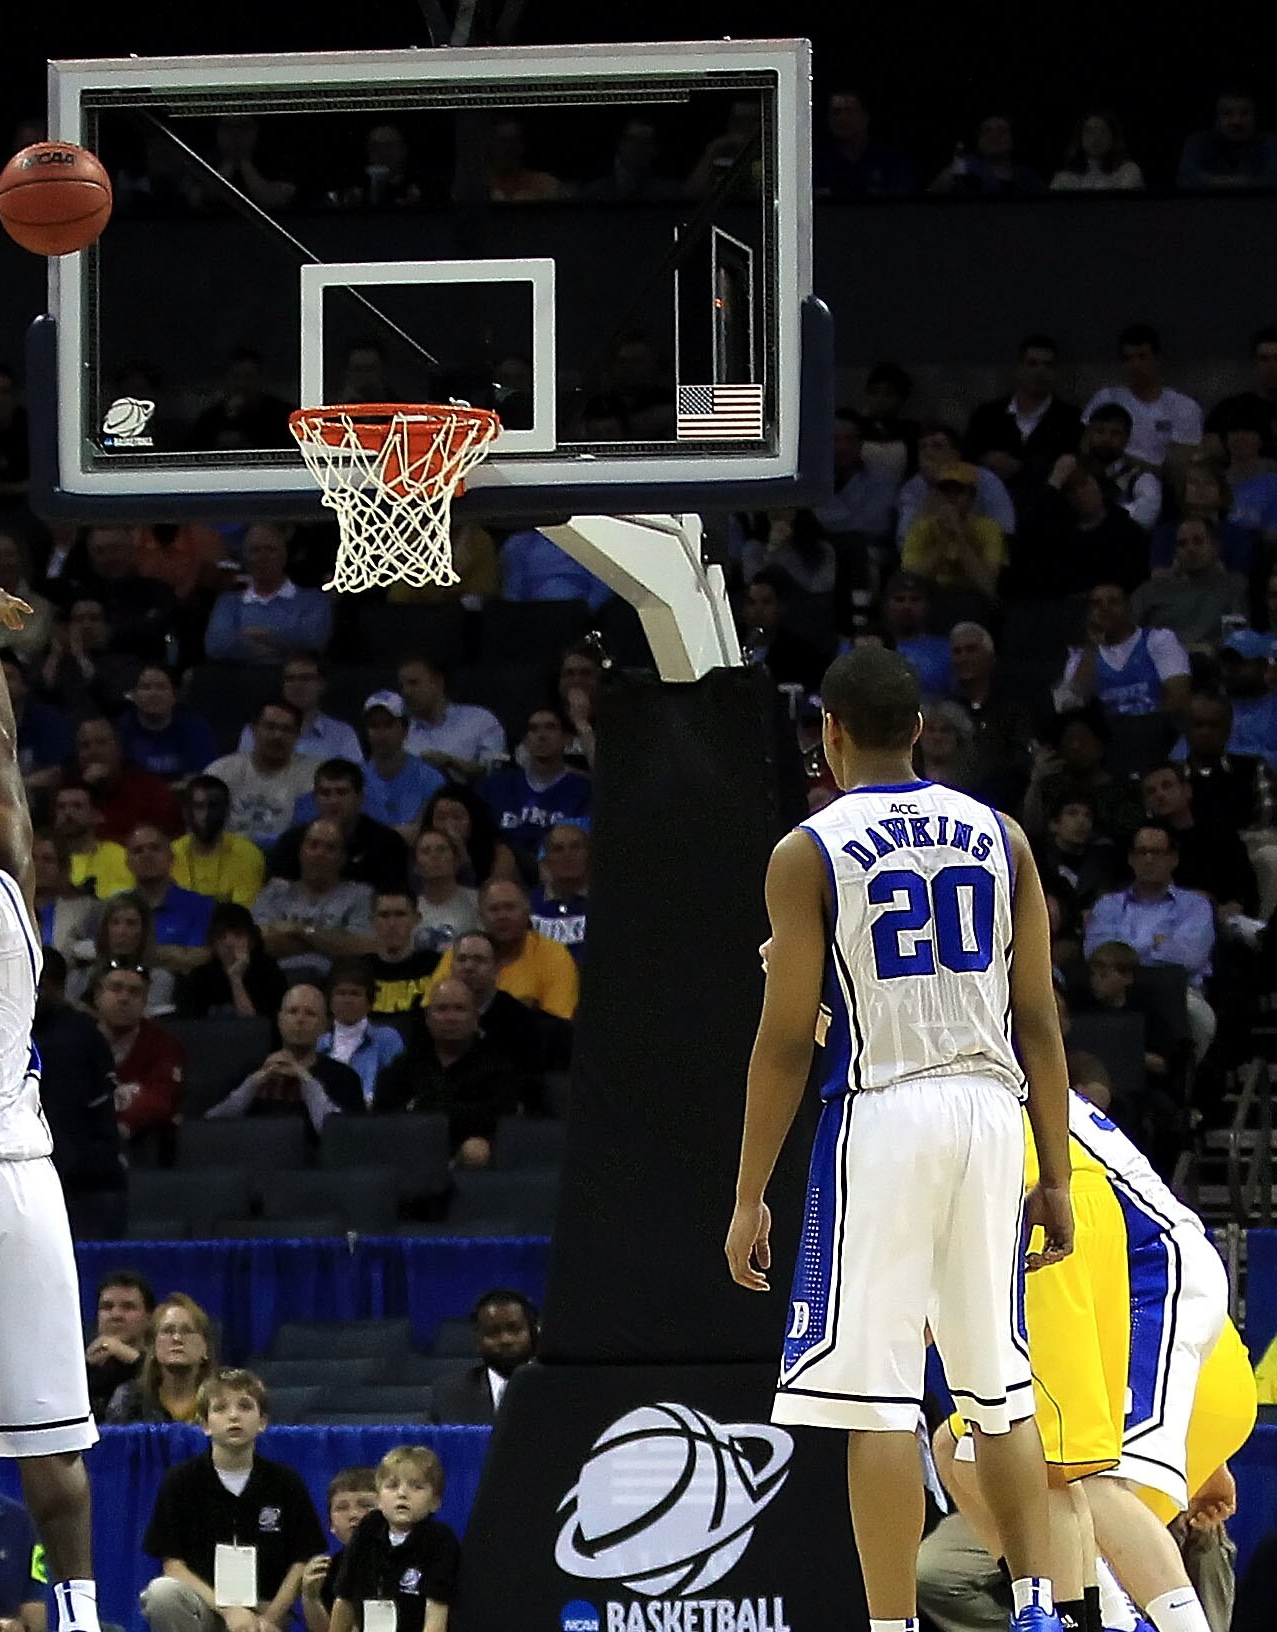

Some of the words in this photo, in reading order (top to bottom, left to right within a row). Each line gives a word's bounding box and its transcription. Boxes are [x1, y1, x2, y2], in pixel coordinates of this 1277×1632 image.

[890, 803, 919, 815] ACC
[841, 816, 994, 872] DAWKINS
[867, 865, 996, 980] 20
[563, 1619, 600, 1632] NCAA
